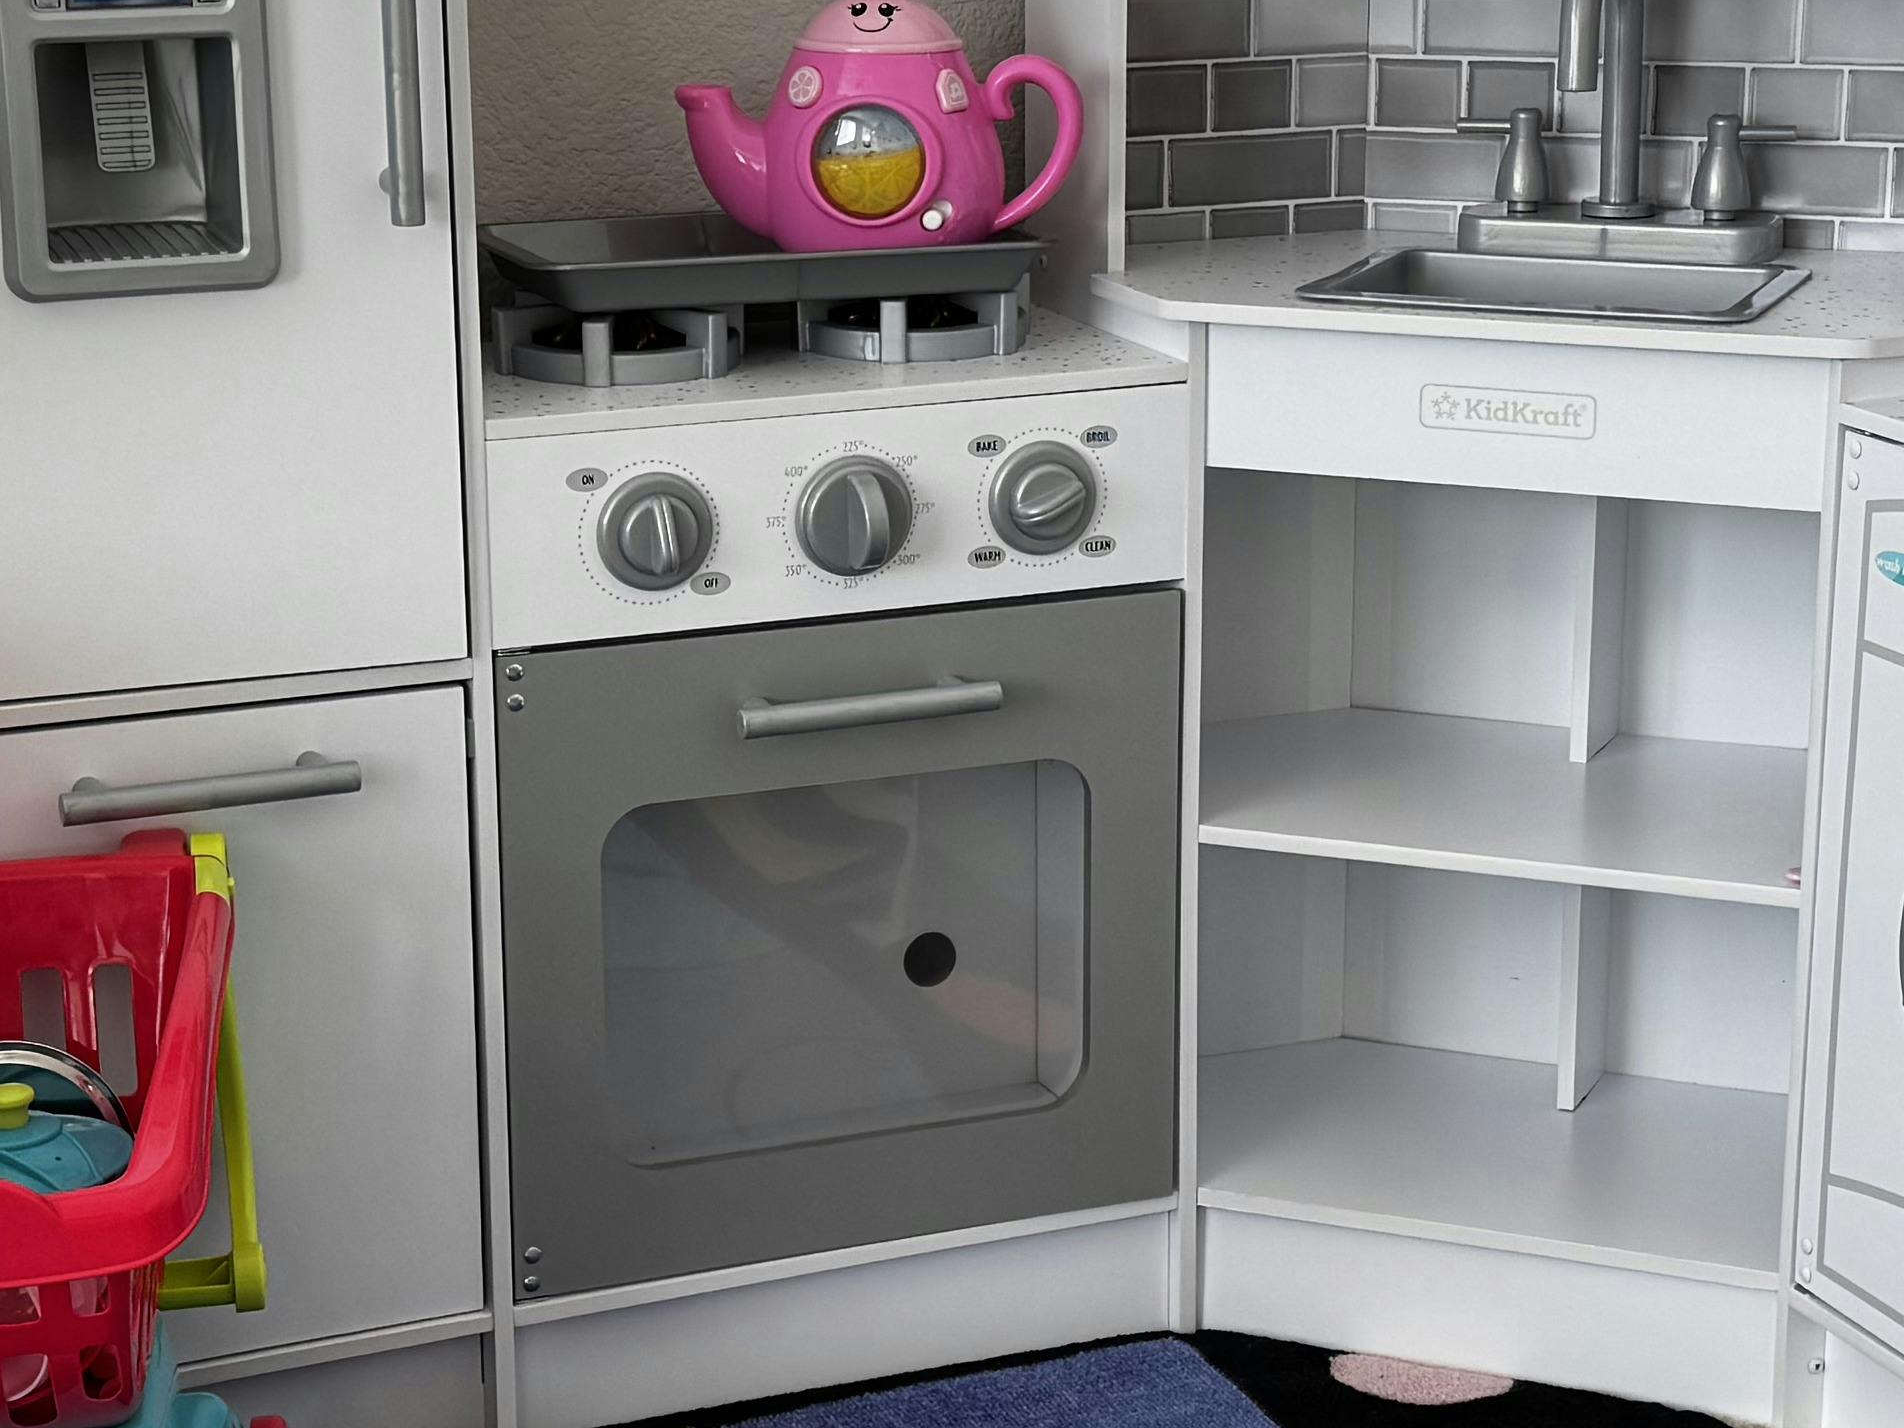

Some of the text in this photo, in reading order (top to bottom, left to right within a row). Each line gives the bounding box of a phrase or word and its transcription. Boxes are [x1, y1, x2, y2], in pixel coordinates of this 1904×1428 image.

[1464, 398, 1583, 427] KidKraft
[976, 440, 998, 452] BAKE
[582, 474, 595, 486] ON
[1085, 540, 1112, 553] CLEAN
[974, 551, 1001, 564] WARM
[1877, 557, 1901, 572] wash
